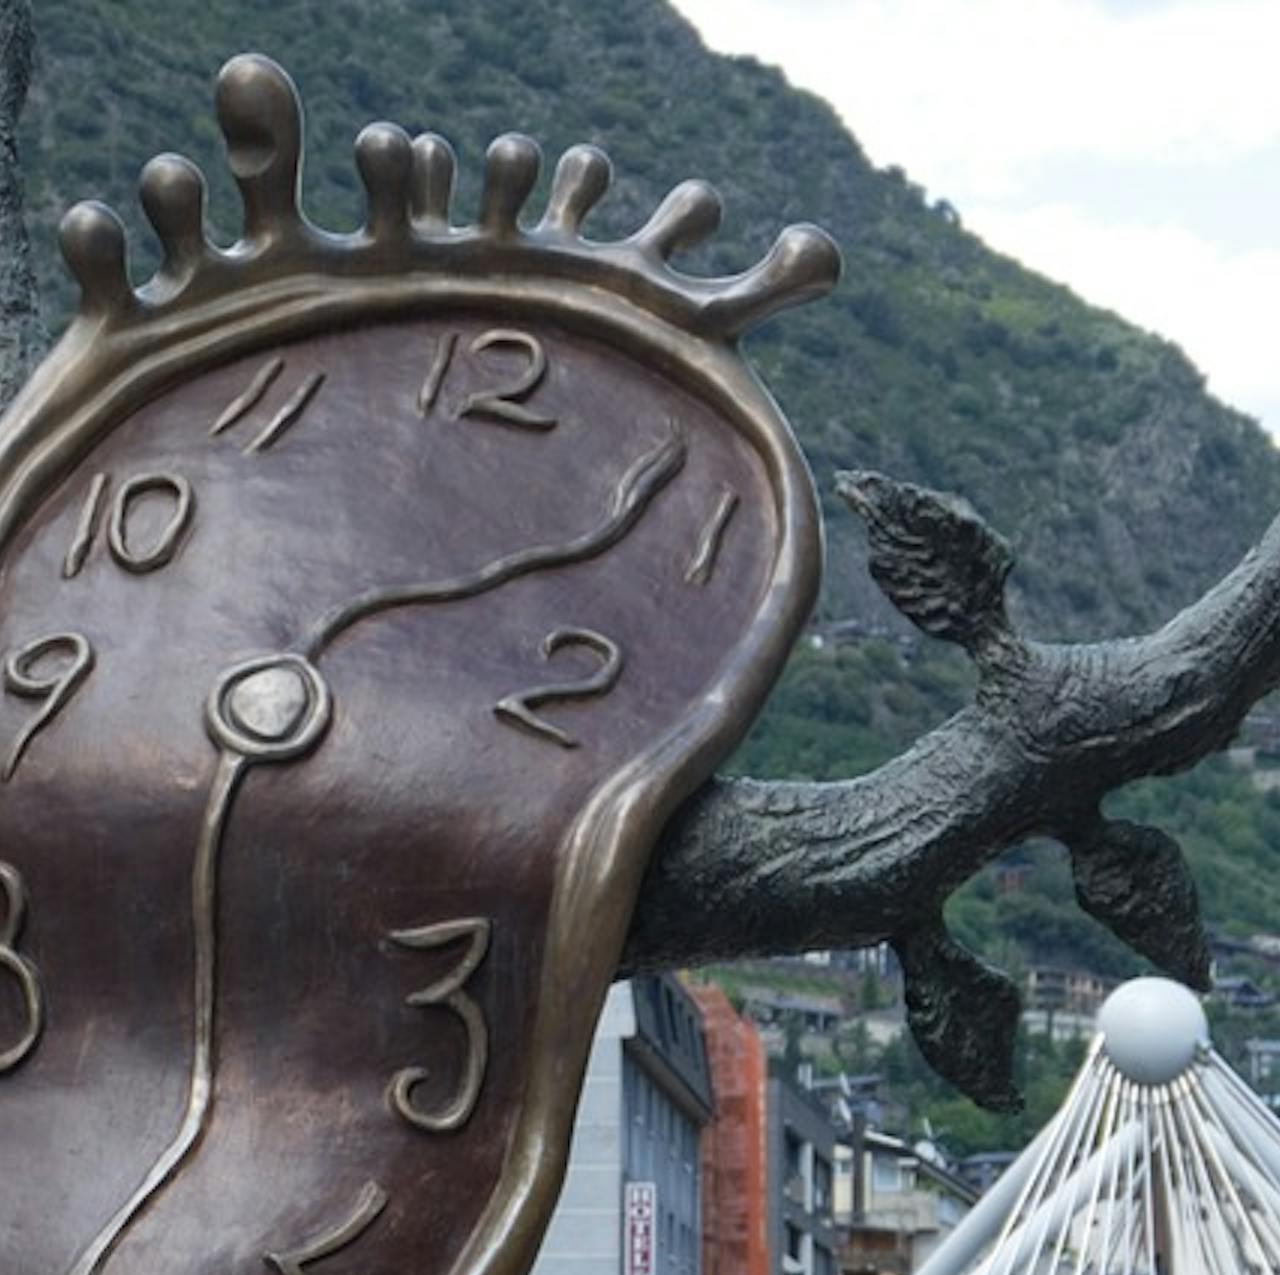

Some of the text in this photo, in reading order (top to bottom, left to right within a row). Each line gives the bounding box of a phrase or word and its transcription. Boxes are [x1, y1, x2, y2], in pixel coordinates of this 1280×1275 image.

[210, 358, 325, 454] 11
[418, 330, 557, 430] 12
[63, 472, 194, 578] 10
[686, 492, 737, 585] 1
[4, 631, 95, 782] 9
[493, 629, 623, 749] 2
[389, 917, 494, 1132] 3
